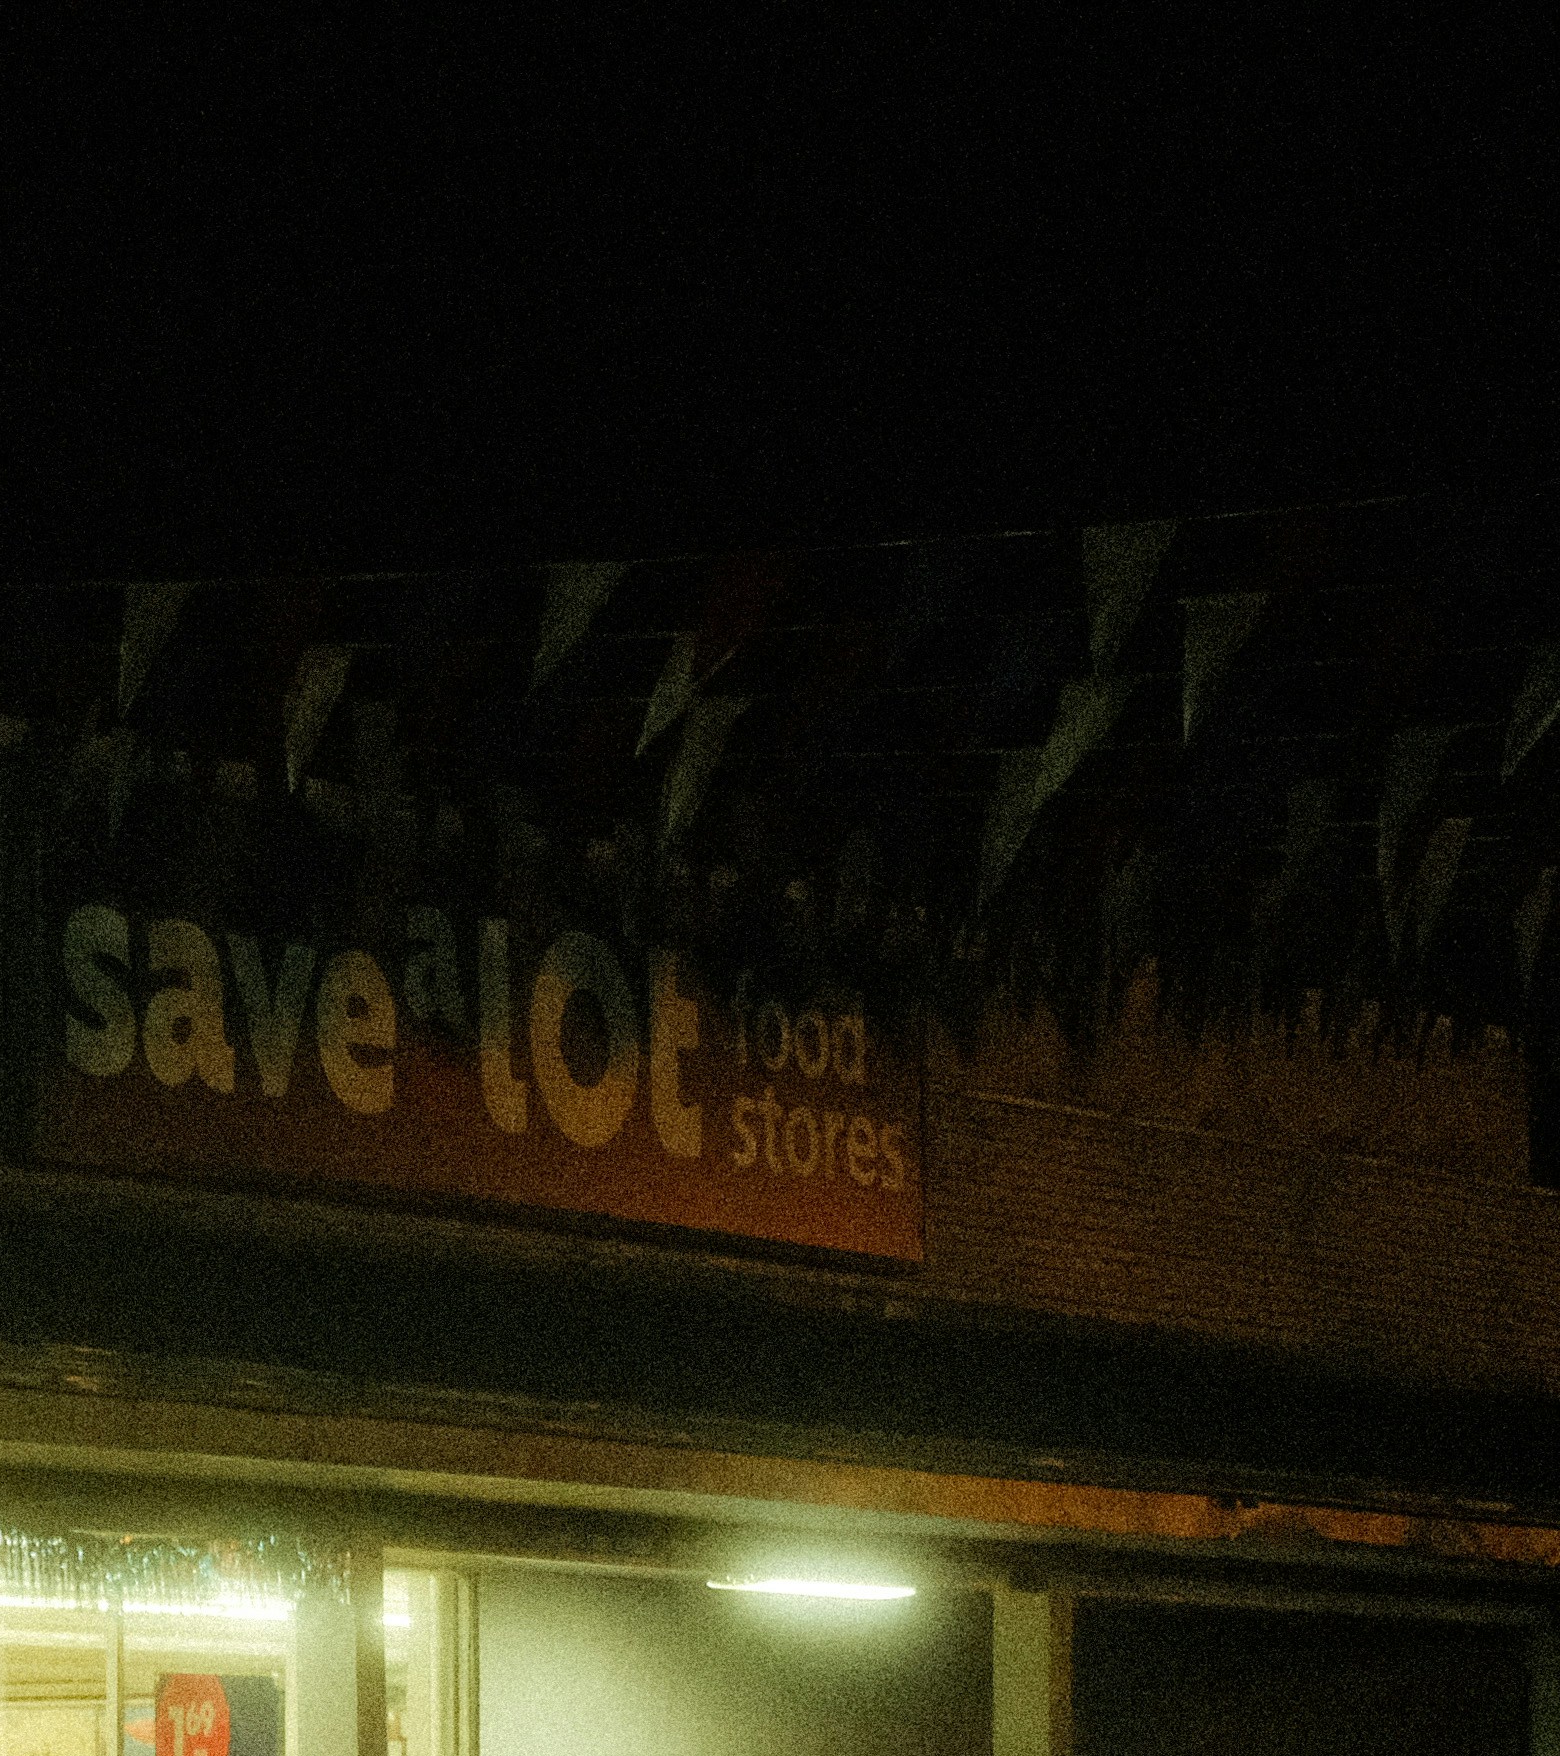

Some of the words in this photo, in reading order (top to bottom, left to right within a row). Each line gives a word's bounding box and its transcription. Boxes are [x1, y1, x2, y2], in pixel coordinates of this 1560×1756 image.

[60, 904, 398, 1115] save
[405, 906, 467, 1018] a
[477, 917, 703, 1158] lot
[734, 972, 866, 1086] food
[731, 1089, 905, 1192] stores
